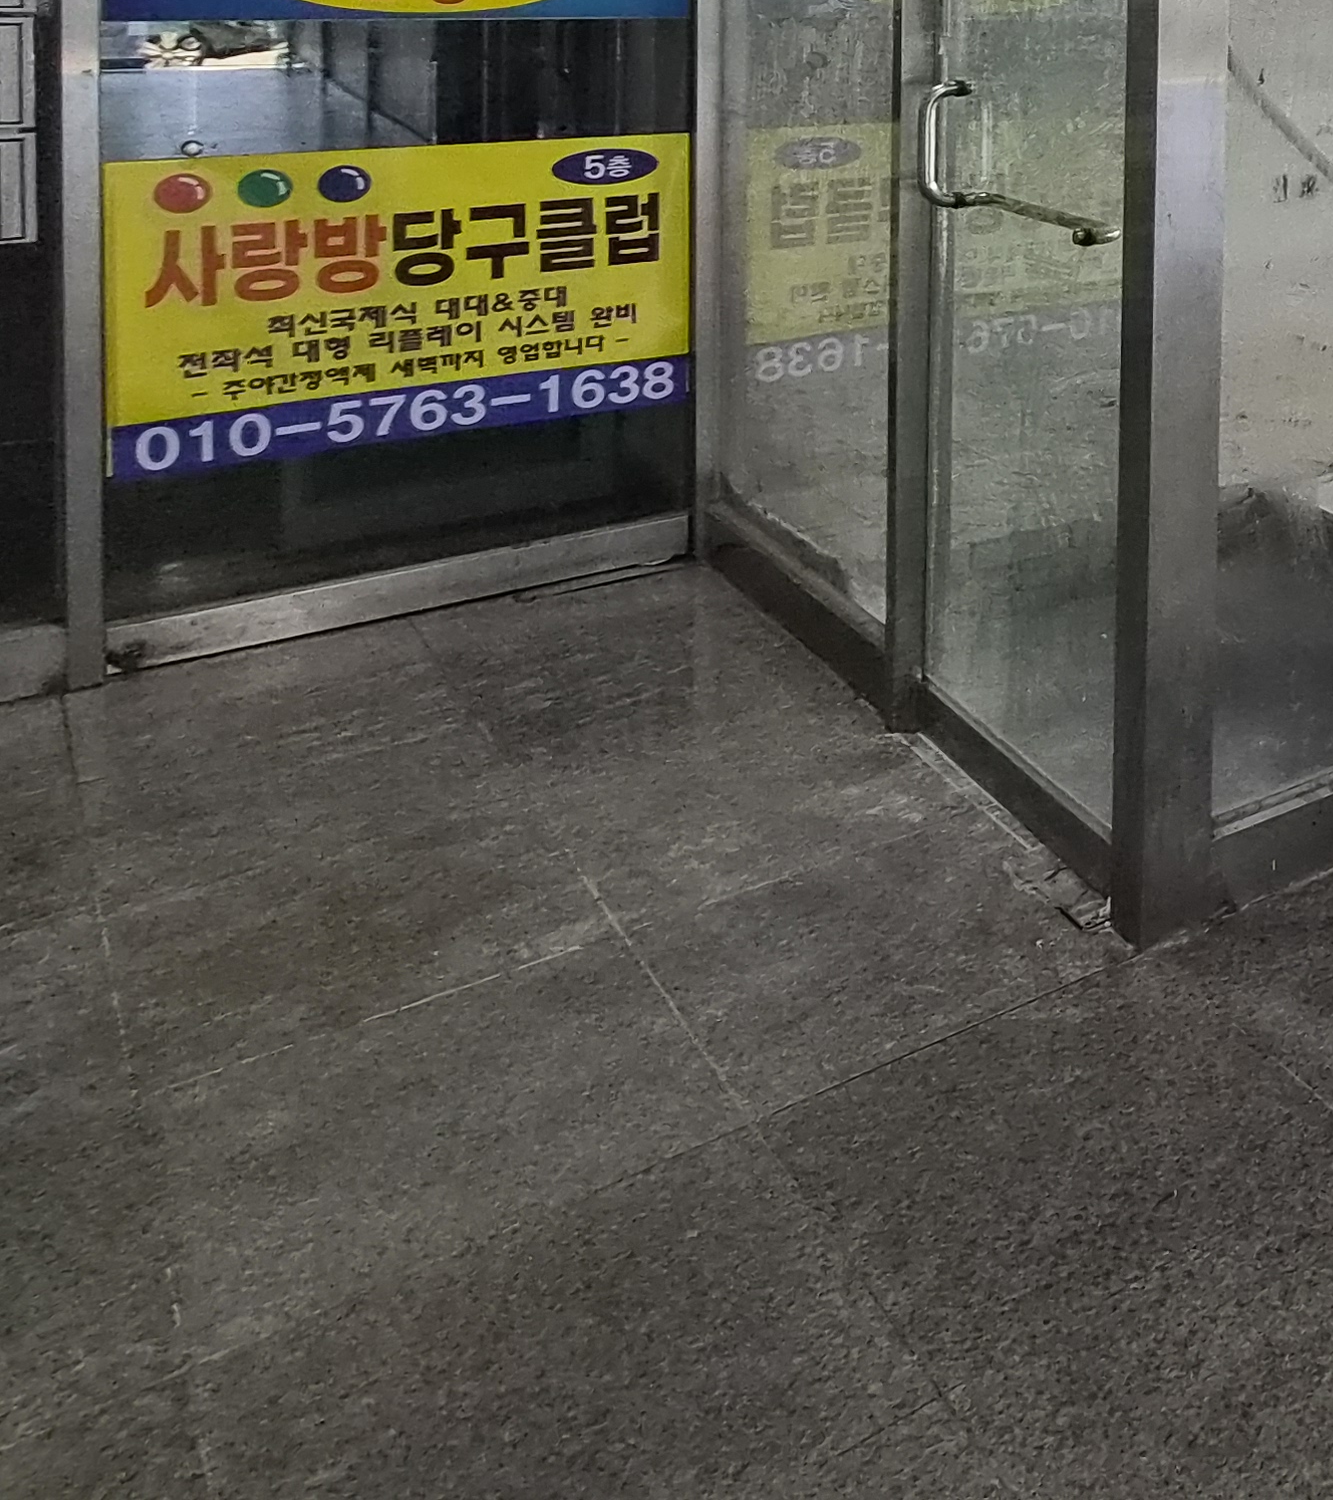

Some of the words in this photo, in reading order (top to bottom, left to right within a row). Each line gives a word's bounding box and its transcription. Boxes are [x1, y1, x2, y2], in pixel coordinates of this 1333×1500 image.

[584, 155, 632, 180] 5층
[177, 345, 273, 378] 전좌석
[292, 335, 351, 362] 대형
[368, 320, 482, 353] 리플레이
[498, 309, 576, 337] 시스템
[590, 303, 637, 328] 완비
[267, 301, 417, 337] 최신국제식
[434, 286, 567, 320] 대대&중대
[222, 362, 376, 400] 주야간정액제
[391, 350, 484, 378] 새벽까지
[497, 335, 604, 364] 영업합니다
[135, 363, 675, 472] 010-5763-1638
